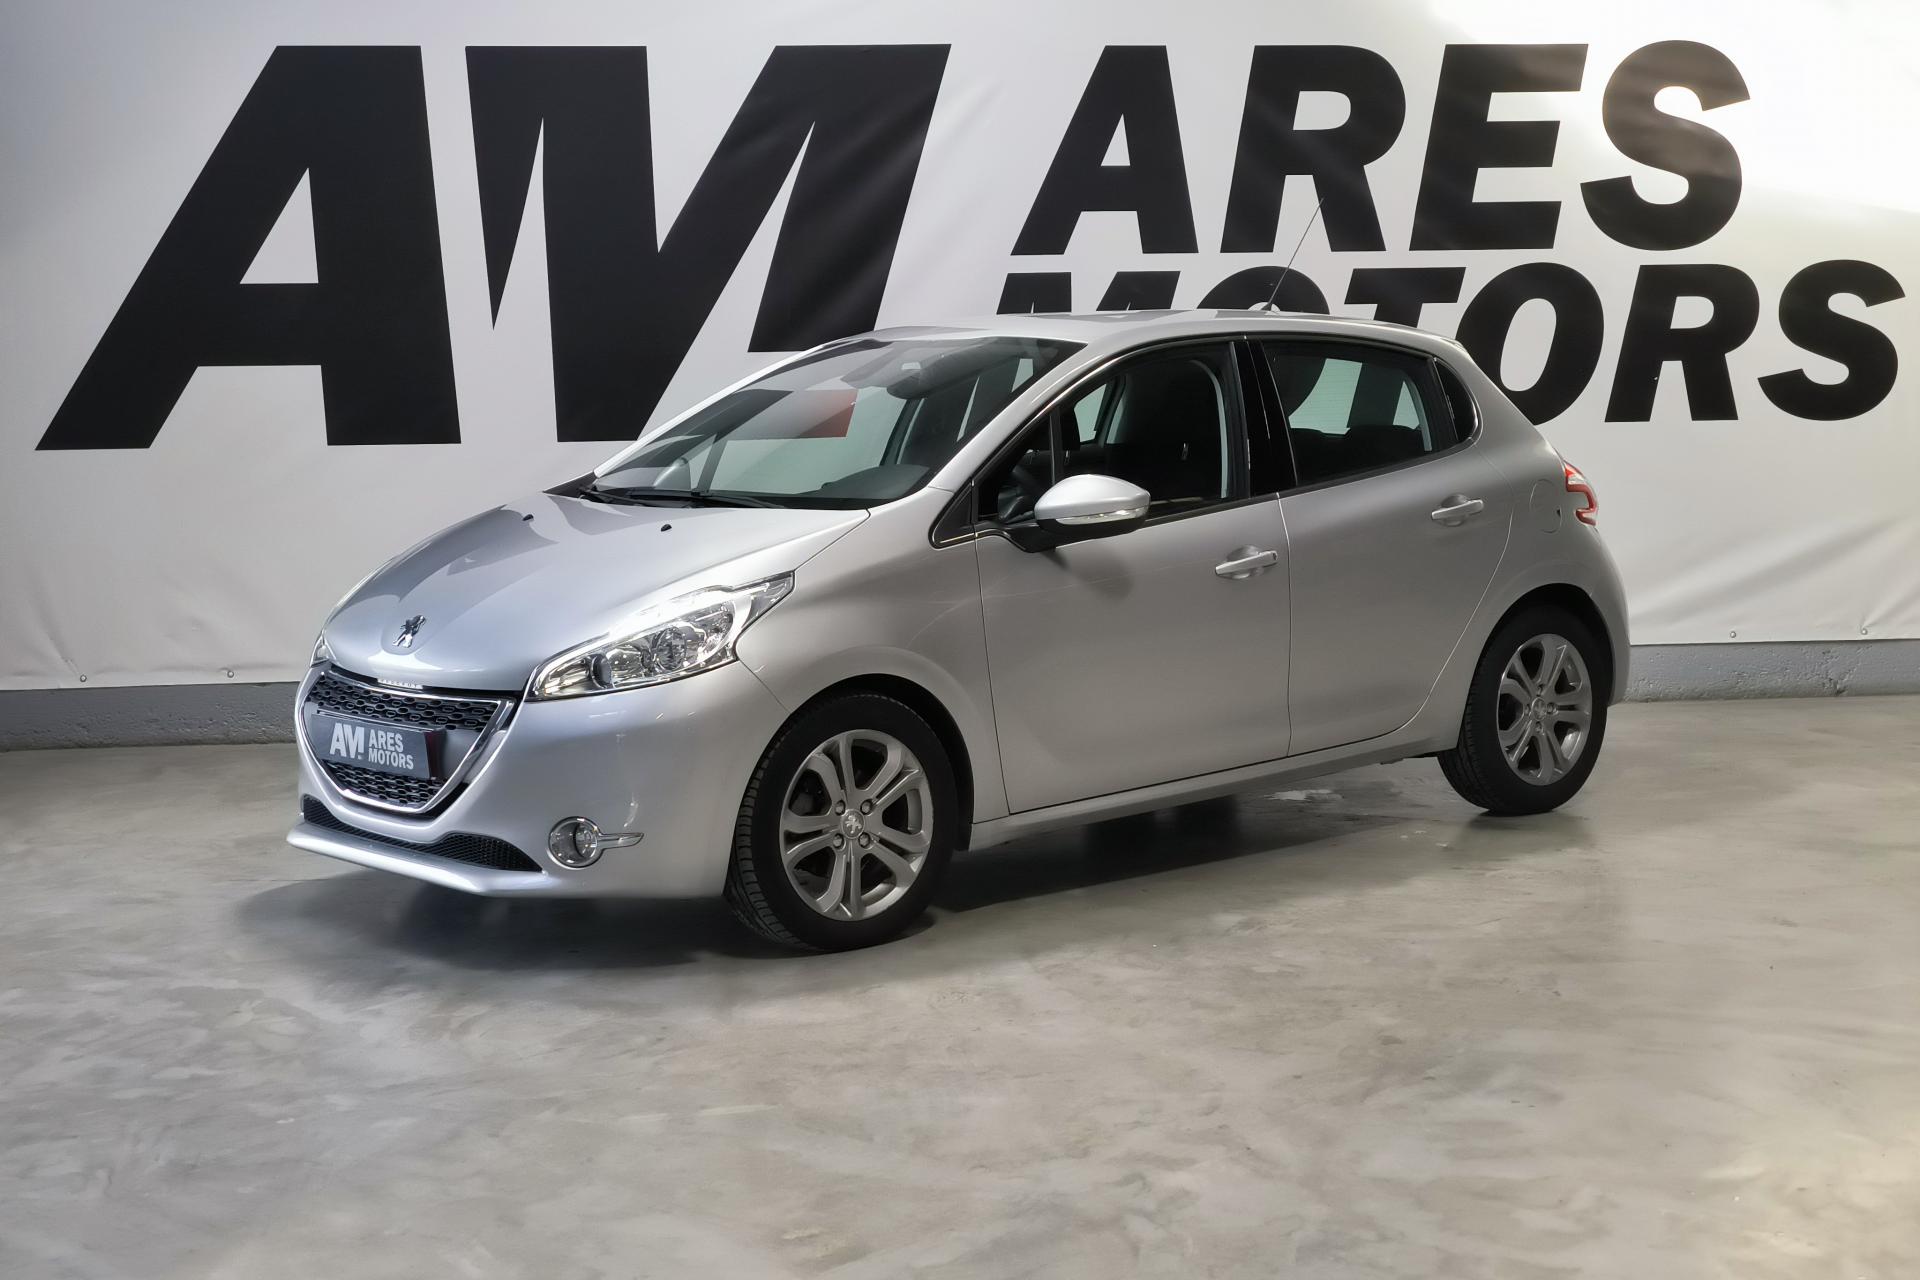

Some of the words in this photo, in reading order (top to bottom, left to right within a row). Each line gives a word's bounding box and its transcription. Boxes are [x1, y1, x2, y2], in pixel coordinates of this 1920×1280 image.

[1010, 40, 1750, 256] ARES
[35, 44, 951, 451] AM
[997, 259, 1906, 426] TORS
[368, 729, 404, 753] ARES
[368, 747, 414, 770] MOTORS
